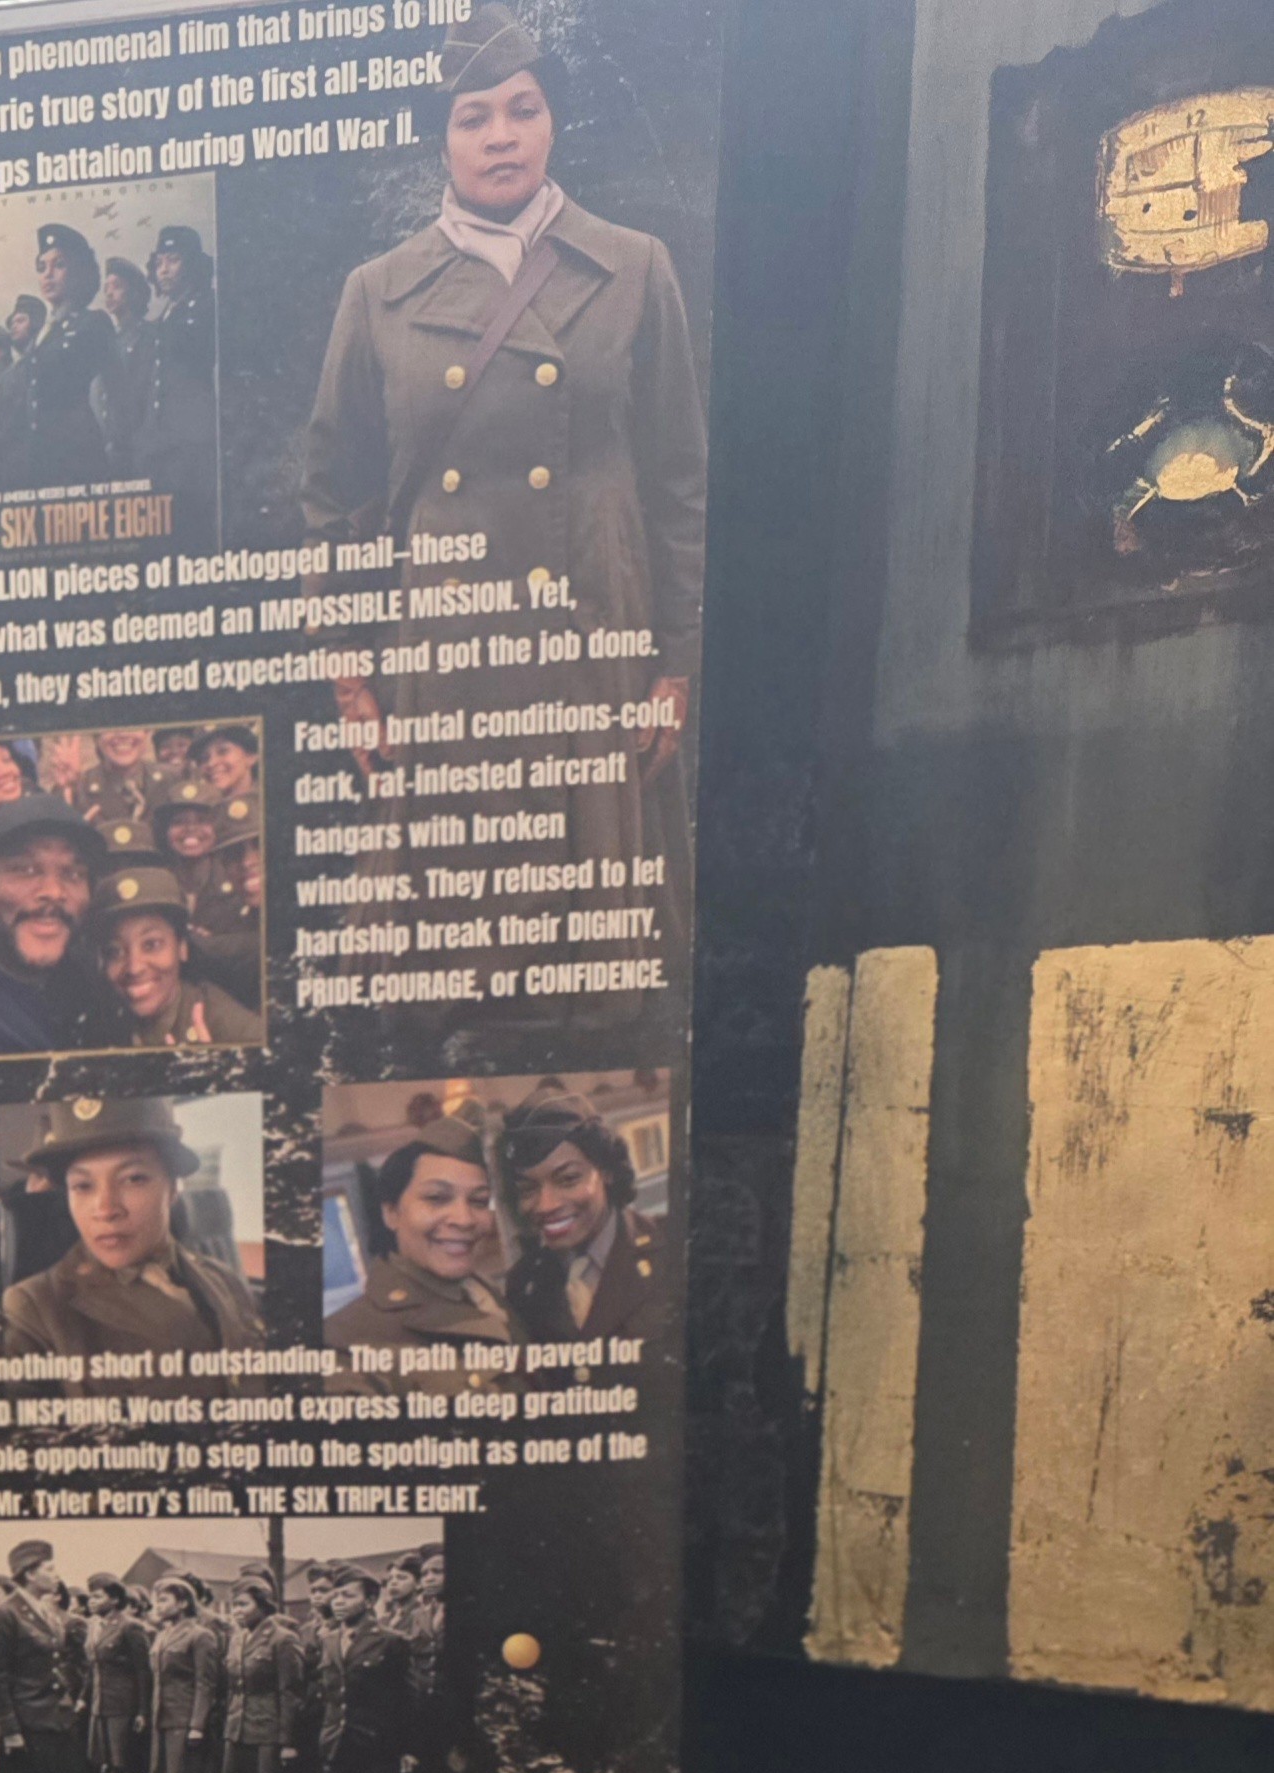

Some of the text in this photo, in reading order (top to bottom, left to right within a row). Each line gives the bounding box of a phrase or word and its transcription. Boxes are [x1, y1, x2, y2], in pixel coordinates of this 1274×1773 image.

[8, 23, 171, 80] phenomenal
[177, 18, 229, 55] film
[236, 9, 291, 48] that
[297, 1, 386, 42] brings
[392, 0, 422, 31] to
[39, 93, 94, 127] true
[101, 85, 170, 121] story
[177, 76, 203, 112] of
[209, 73, 254, 108] the
[260, 64, 317, 102] first
[323, 49, 443, 96] all-Black
[35, 141, 152, 185] battalion
[159, 130, 245, 171] during
[251, 119, 329, 160] World
[336, 116, 389, 152] War
[27, 180, 174, 205] WASHINGTON
[0, 506, 38, 549] SIX
[41, 500, 109, 545] TRIPLE
[113, 494, 173, 539] EIGHT
[53, 561, 139, 601] pieces
[145, 555, 171, 589] of
[177, 540, 329, 586] backlogged
[53, 618, 106, 649] was
[111, 604, 214, 644] deemed
[220, 605, 253, 635] an
[259, 588, 403, 632] IMPOSSIBLE
[408, 579, 520, 619] MISSION.
[527, 576, 577, 611] Yet,
[14, 671, 70, 705] they
[76, 658, 199, 699] shattered
[205, 647, 374, 692] expectations
[380, 639, 430, 675] and
[436, 636, 481, 674] got
[487, 633, 531, 667] the
[537, 628, 581, 665] job
[587, 626, 659, 659] done.
[294, 715, 380, 752] Facing
[385, 708, 464, 745] brutal
[294, 750, 626, 804] dark, rat-infested aircraft
[295, 809, 565, 856] hangars with broken
[295, 854, 664, 907] windows. They refused to let
[295, 906, 661, 958] hardship break their DIGNITY,
[489, 957, 668, 997] or CONFIDENCE.
[89, 1349, 153, 1379] short
[189, 1344, 344, 1377] outstanding.
[348, 1343, 393, 1373] The
[398, 1342, 457, 1376] path
[462, 1341, 520, 1373] they
[525, 1337, 602, 1369] paved
[608, 1335, 644, 1365] for
[208, 1392, 294, 1423] cannot
[299, 1394, 400, 1424] express
[405, 1390, 448, 1419] the
[453, 1388, 517, 1421] deep
[523, 1383, 637, 1420] gratitude
[32, 1431, 647, 1475] opportunity to step into the spotlight as one of the
[34, 1488, 91, 1519] Tyler
[186, 1485, 240, 1517] film,
[246, 1485, 286, 1513] THE
[292, 1485, 329, 1513] SIX
[334, 1484, 409, 1513] TRIPLE
[415, 1484, 486, 1513] EIGHT.
